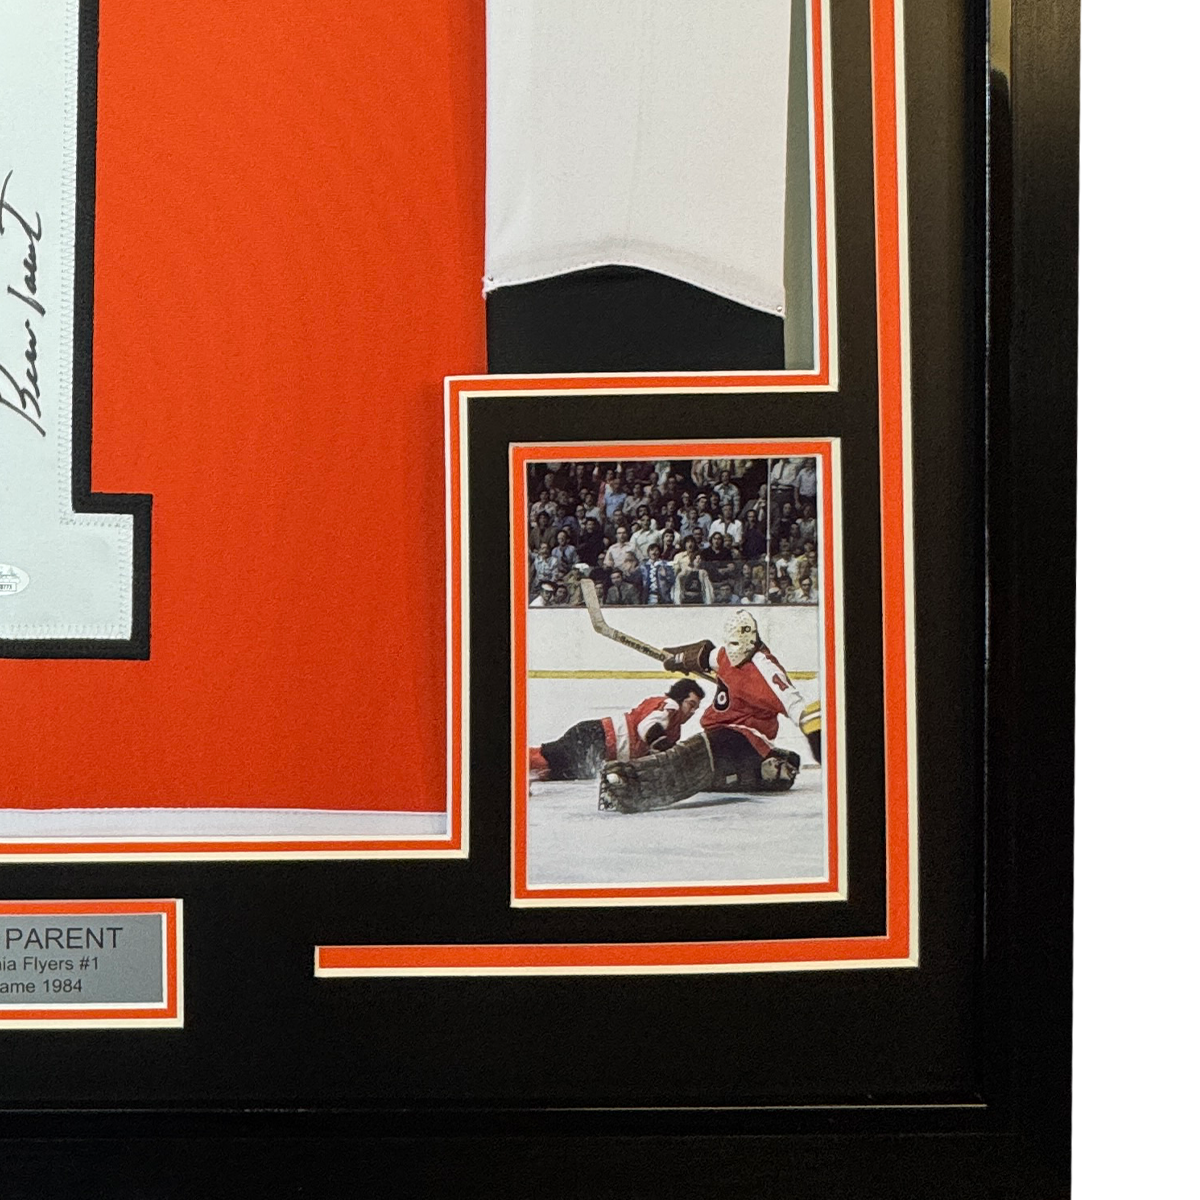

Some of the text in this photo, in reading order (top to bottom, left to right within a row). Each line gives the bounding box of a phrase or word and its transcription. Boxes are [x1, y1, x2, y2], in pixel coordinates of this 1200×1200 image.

[5, 927, 124, 950] PARENT
[23, 956, 74, 974] Flyers
[79, 957, 98, 971] #1
[42, 978, 83, 993] 1984
